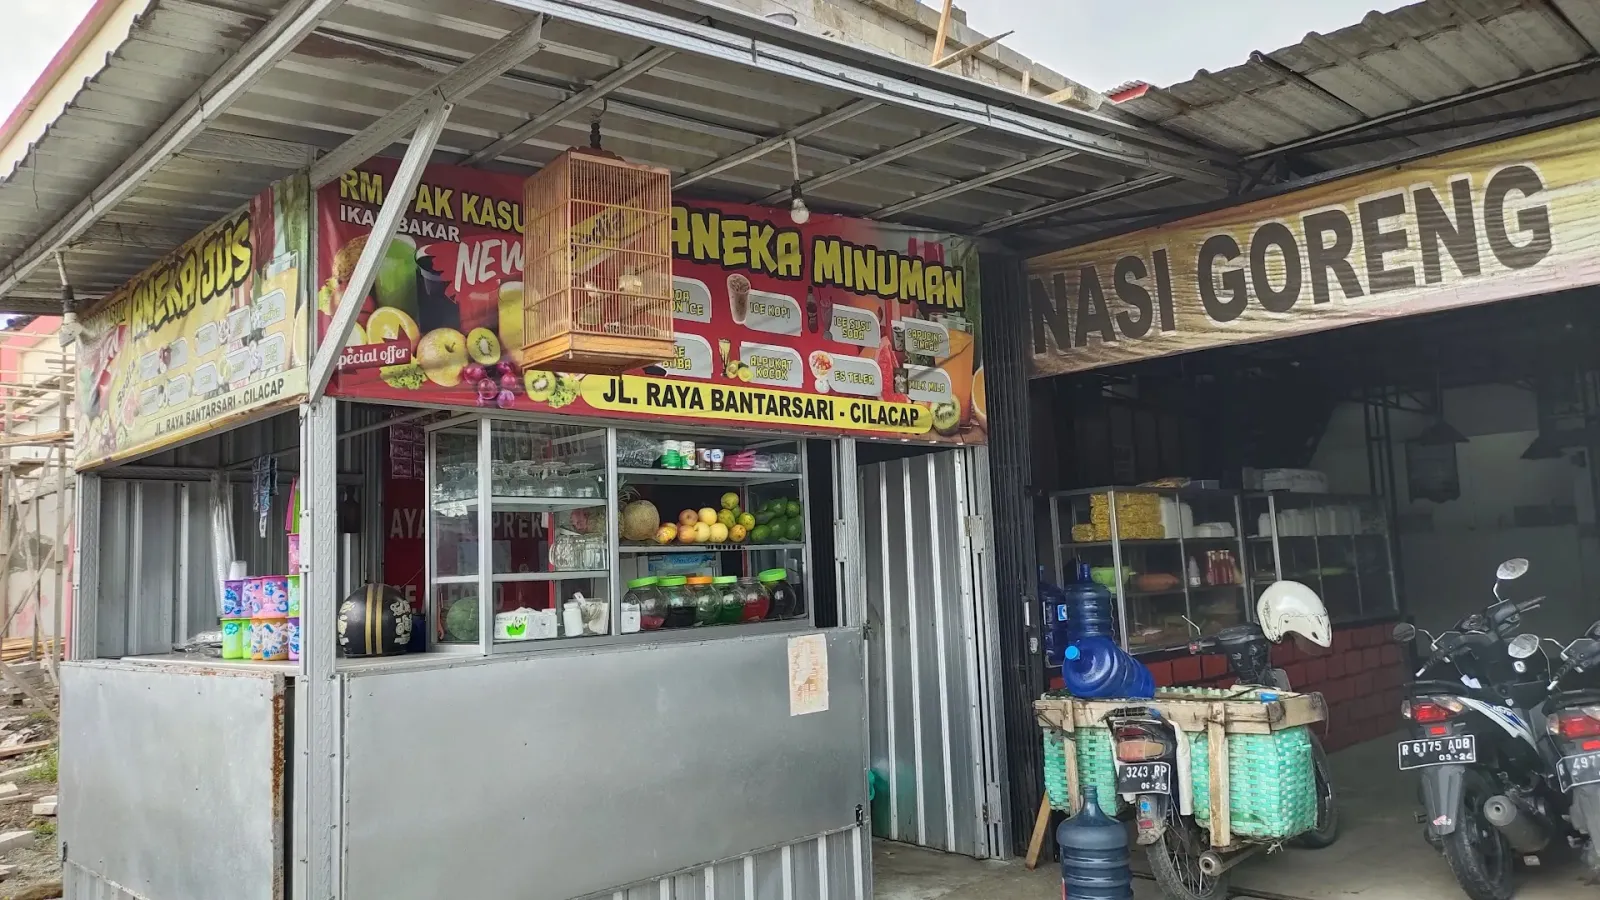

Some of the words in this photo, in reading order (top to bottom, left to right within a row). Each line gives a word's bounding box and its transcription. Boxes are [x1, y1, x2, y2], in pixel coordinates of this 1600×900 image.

[341, 170, 383, 205] RM
[409, 182, 454, 219] AK
[462, 192, 526, 235] KASU
[340, 204, 380, 227] IKA
[397, 217, 461, 243] BAKAR
[454, 238, 525, 294] NEW
[660, 204, 803, 279] ANEKA
[811, 238, 964, 311] MINUMAN
[1030, 248, 1176, 356] NASI
[1199, 163, 1554, 324] GORENG
[131, 251, 198, 340] ANEKA
[200, 211, 254, 305] JUS
[686, 302, 704, 316] ICE
[750, 302, 766, 315] ICE
[768, 304, 791, 319] KOPI
[834, 315, 848, 327] ICE
[848, 318, 872, 332] SUSU
[841, 328, 864, 341] SODA
[336, 348, 378, 370] pecial
[380, 345, 408, 364] offer
[750, 354, 793, 371] ALPUKAT
[755, 366, 788, 381] KOCOK
[834, 370, 846, 382] ES
[848, 371, 874, 385] TELER
[909, 379, 927, 391] MILK
[928, 381, 946, 393] MILO
[166, 415, 184, 433] RAYA
[186, 394, 236, 426] BANTARSARI
[244, 377, 285, 405] CILACAP
[602, 378, 638, 405] JL.
[646, 382, 705, 411] RAYA
[711, 388, 834, 421] BANTARSARI
[850, 402, 919, 428] CILACAP
[1402, 744, 1409, 756] R
[1413, 740, 1442, 754] 6175
[1573, 754, 1600, 770] 497
[1126, 765, 1148, 778] 3243
[1152, 764, 1168, 779] RP
